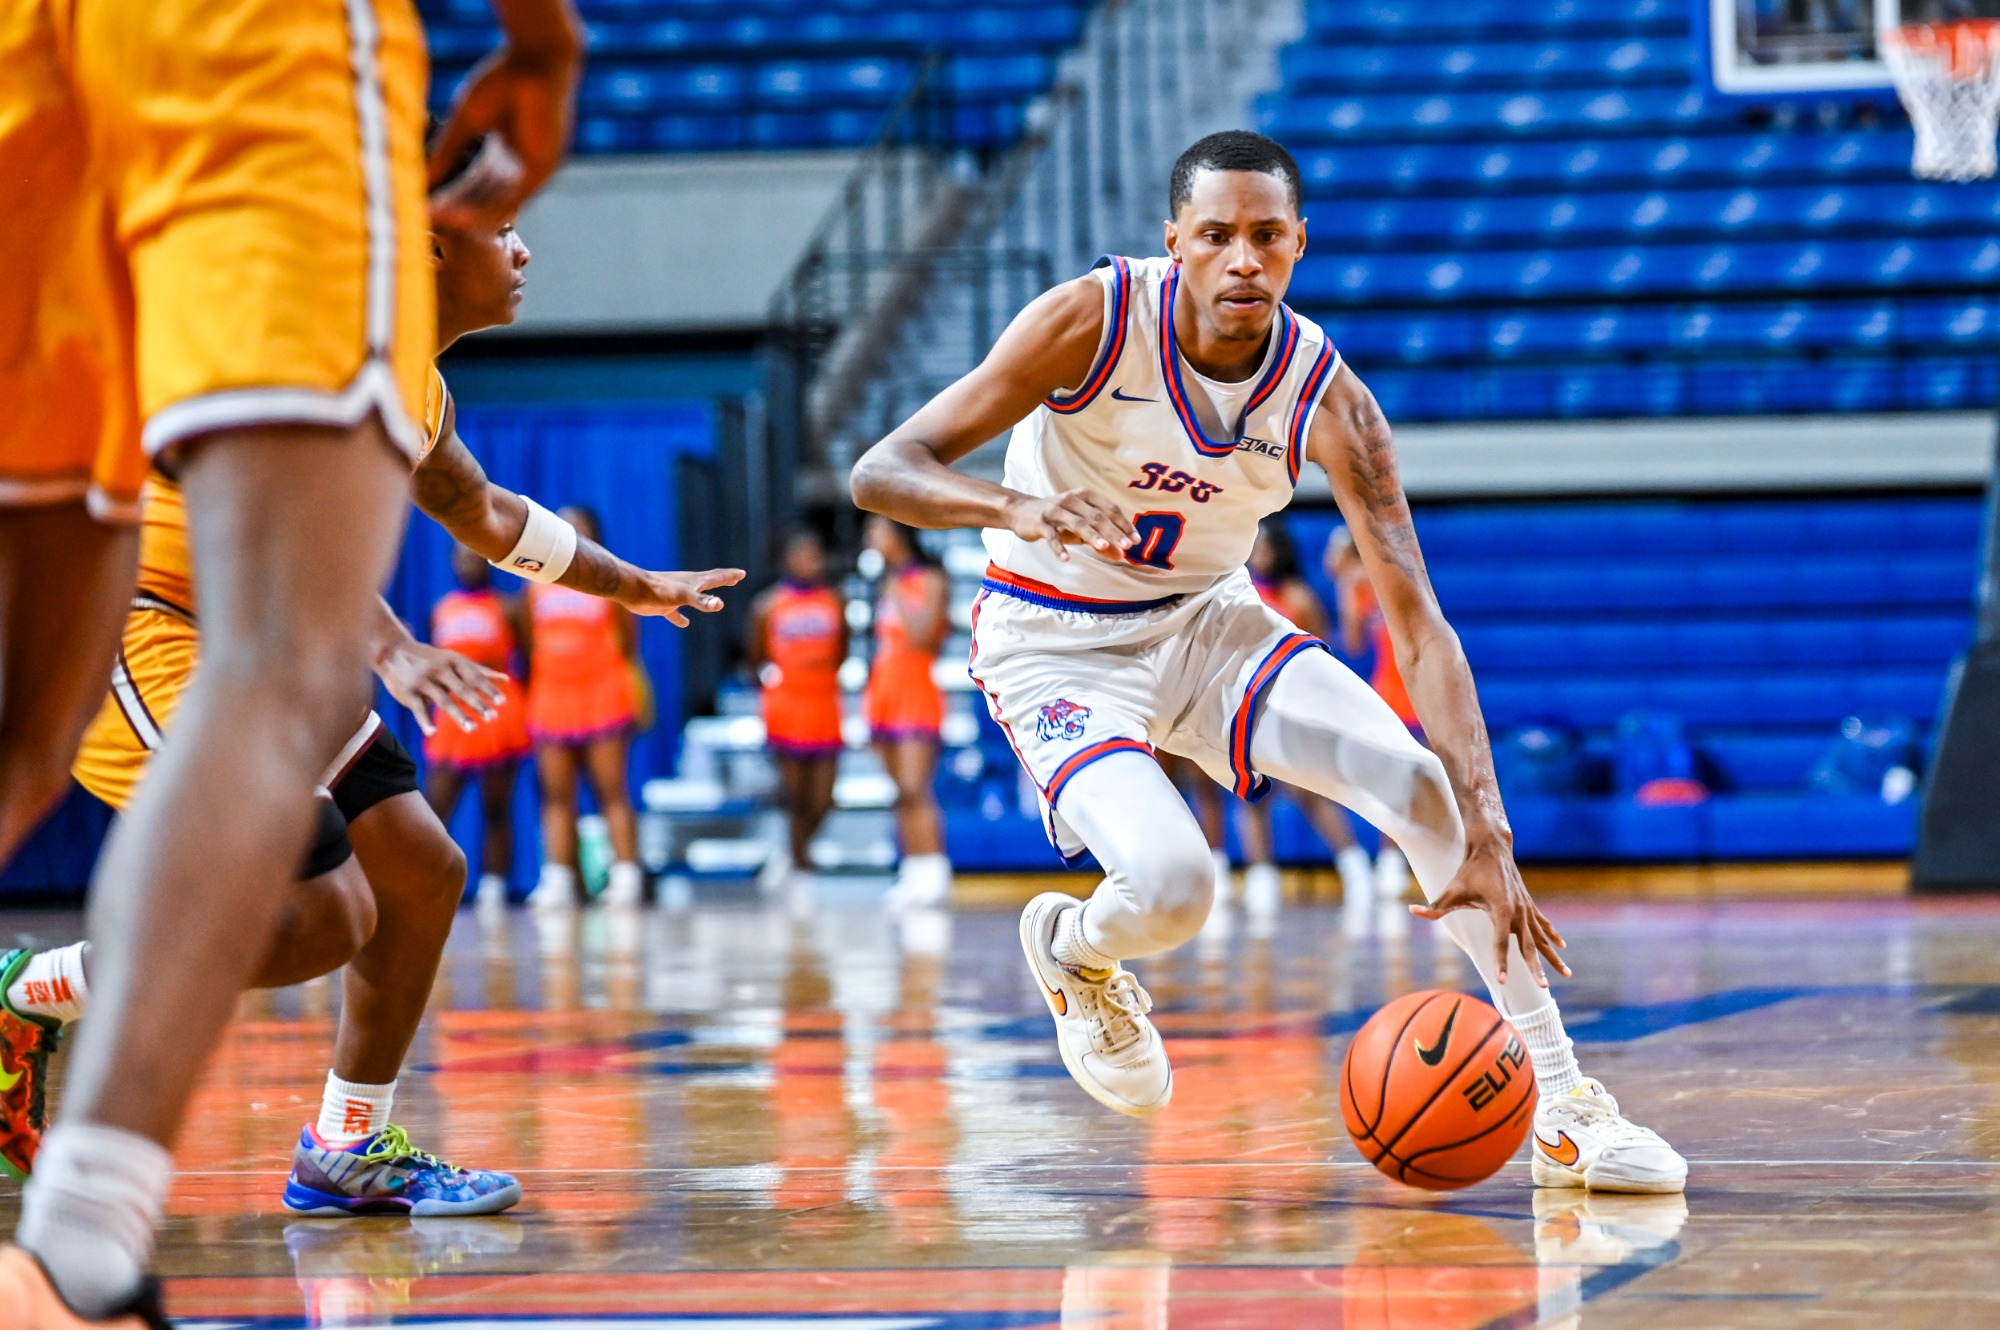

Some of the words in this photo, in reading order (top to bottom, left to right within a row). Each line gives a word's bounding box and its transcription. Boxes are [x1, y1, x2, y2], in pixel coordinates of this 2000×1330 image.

[1237, 438, 1284, 458] SIAC
[1127, 462, 1224, 503] SSU
[1124, 511, 1187, 570] 0
[1462, 1033, 1526, 1113] ELITE
